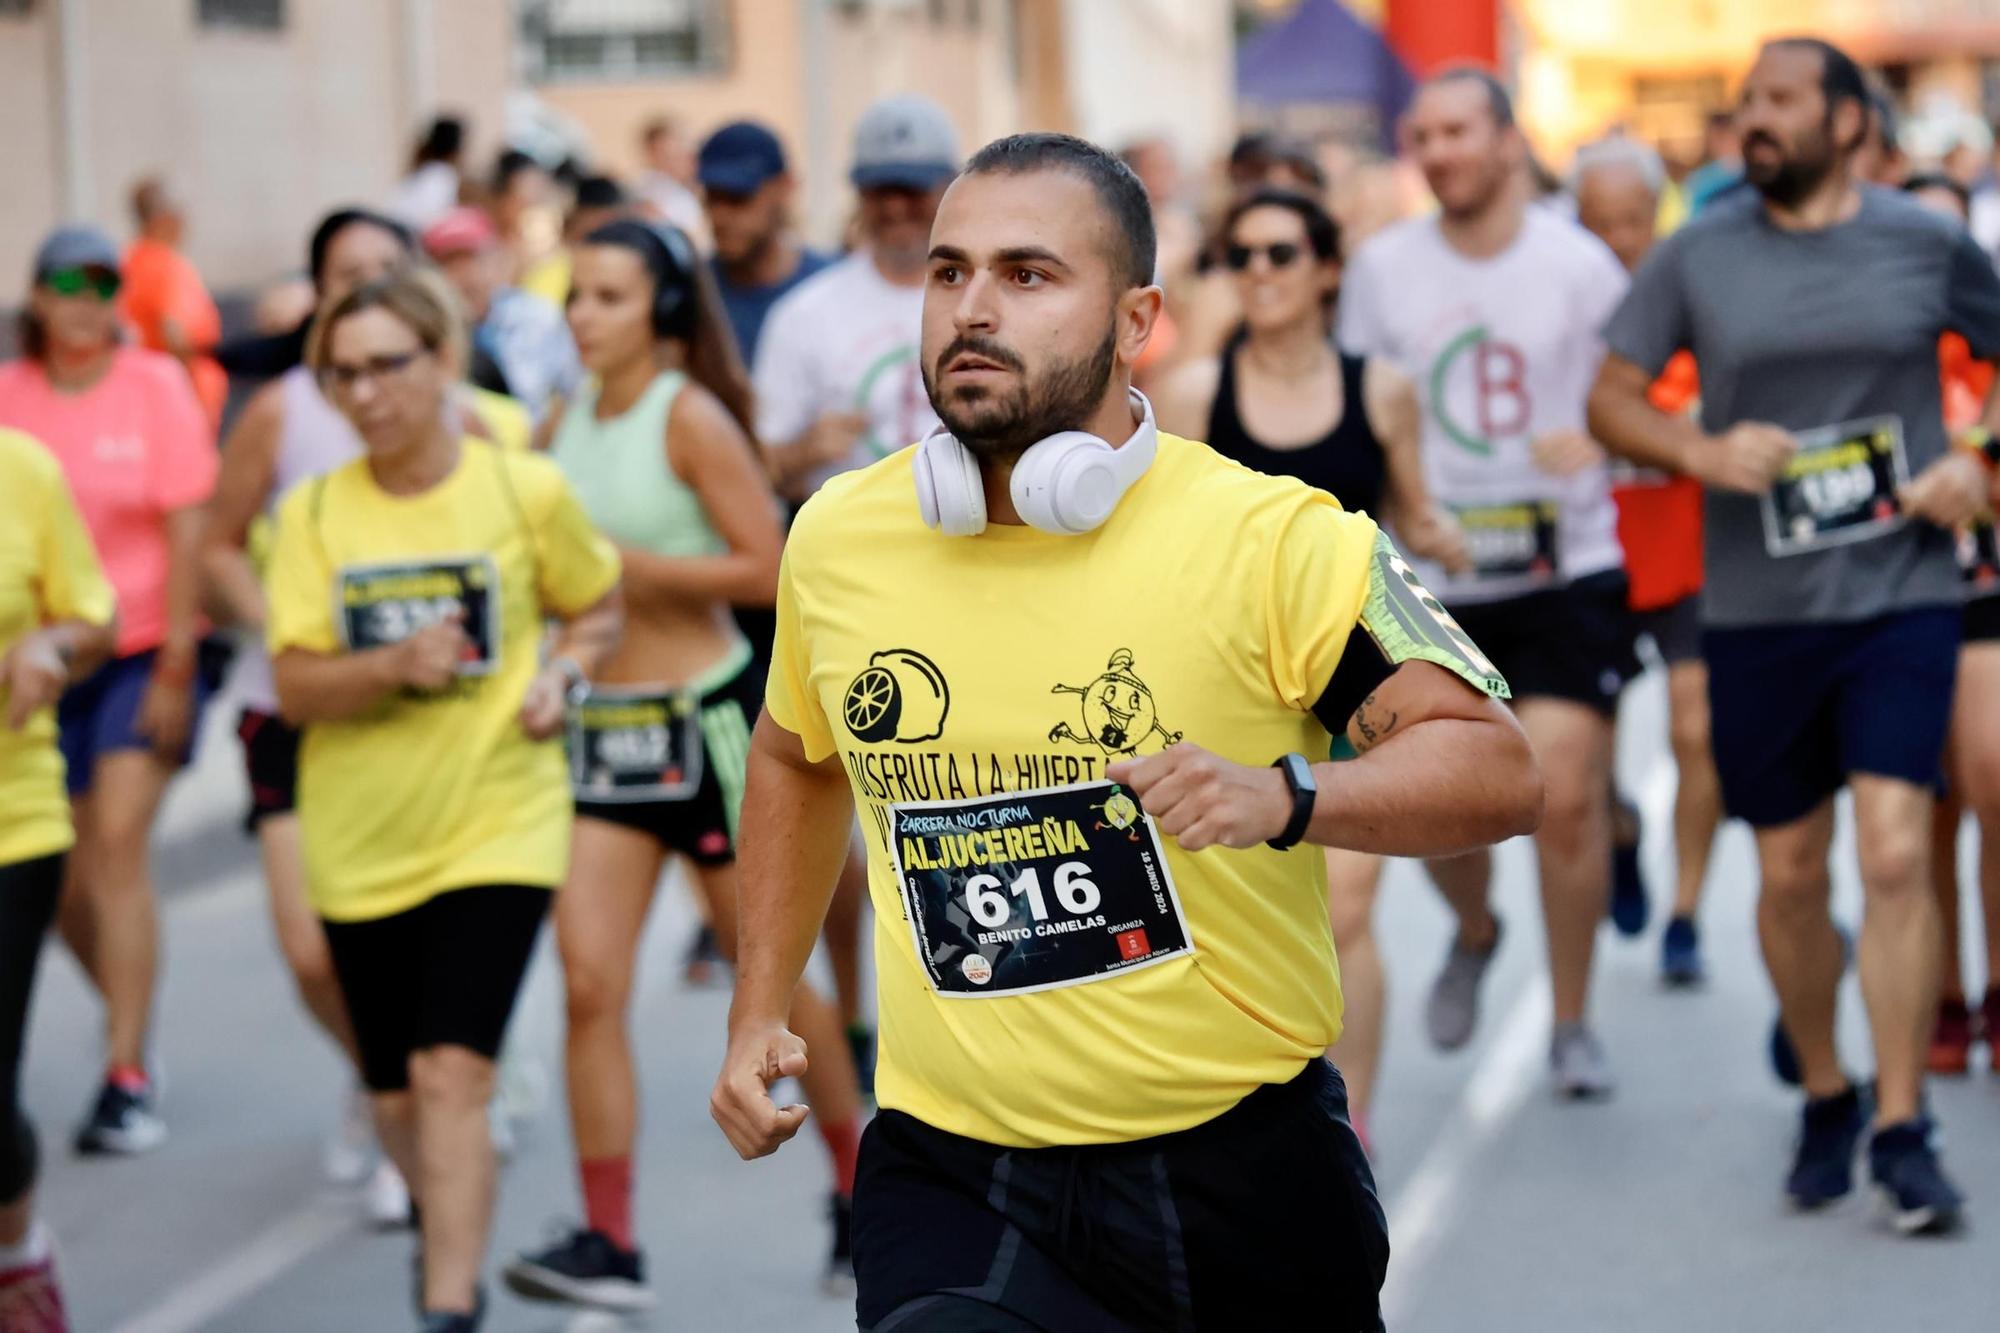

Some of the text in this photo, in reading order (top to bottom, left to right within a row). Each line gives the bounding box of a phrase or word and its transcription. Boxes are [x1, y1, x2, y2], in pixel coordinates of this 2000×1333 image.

[848, 751, 967, 801] DISFRUTA
[900, 814, 953, 834] CARRERA
[956, 805, 1033, 829] NOCTURNA
[902, 816, 1090, 872] ALJUCEREÑA
[965, 861, 1101, 928] 616
[1144, 864, 1161, 892] JUNIO
[1154, 892, 1168, 914] 2024
[978, 915, 1107, 945] BENITO CAMELAS
[1107, 919, 1145, 935] ORGANIZA
